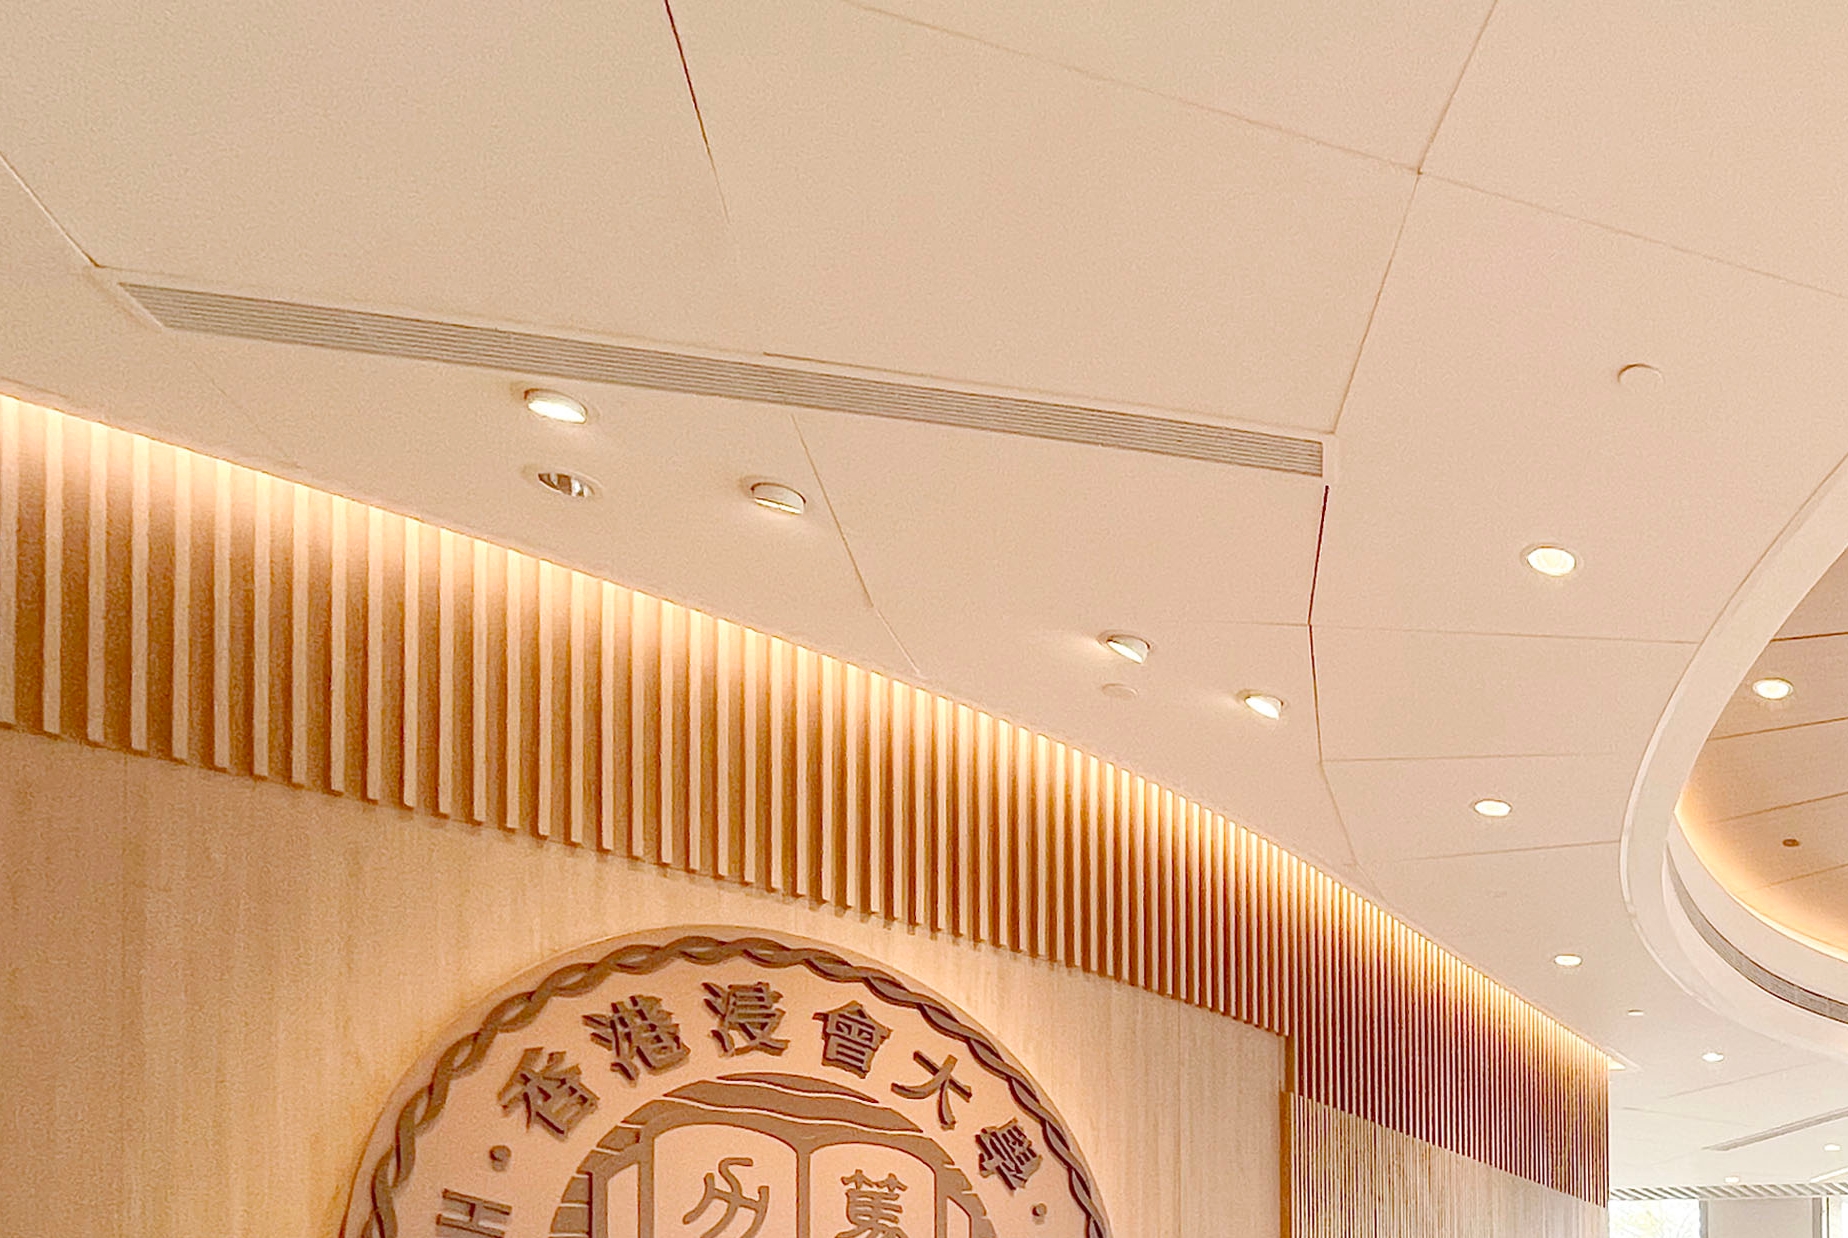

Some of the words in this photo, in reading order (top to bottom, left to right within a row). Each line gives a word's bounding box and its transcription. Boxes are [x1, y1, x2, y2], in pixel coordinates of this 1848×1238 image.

[502, 981, 1043, 1192] 香港浸會大學
